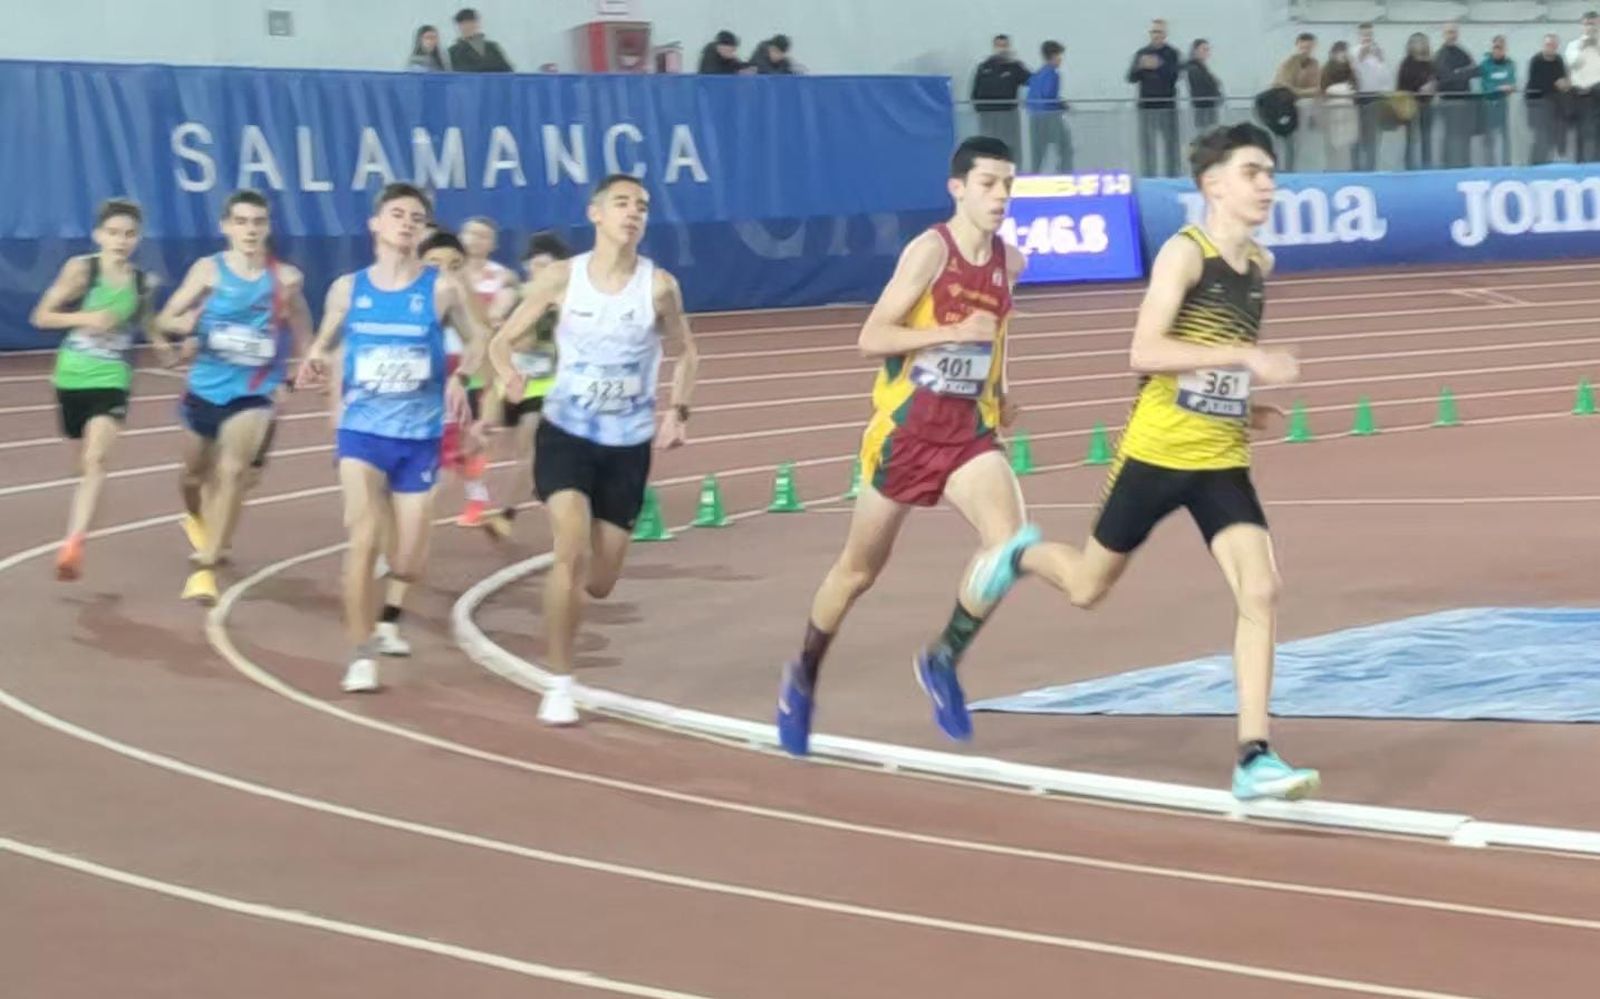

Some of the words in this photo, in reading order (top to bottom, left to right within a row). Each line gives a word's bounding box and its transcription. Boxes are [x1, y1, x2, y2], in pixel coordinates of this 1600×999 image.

[170, 122, 709, 192] SALAMANCA
[1177, 185, 1388, 246] ma
[937, 357, 973, 377] 401
[1203, 370, 1240, 396] 361
